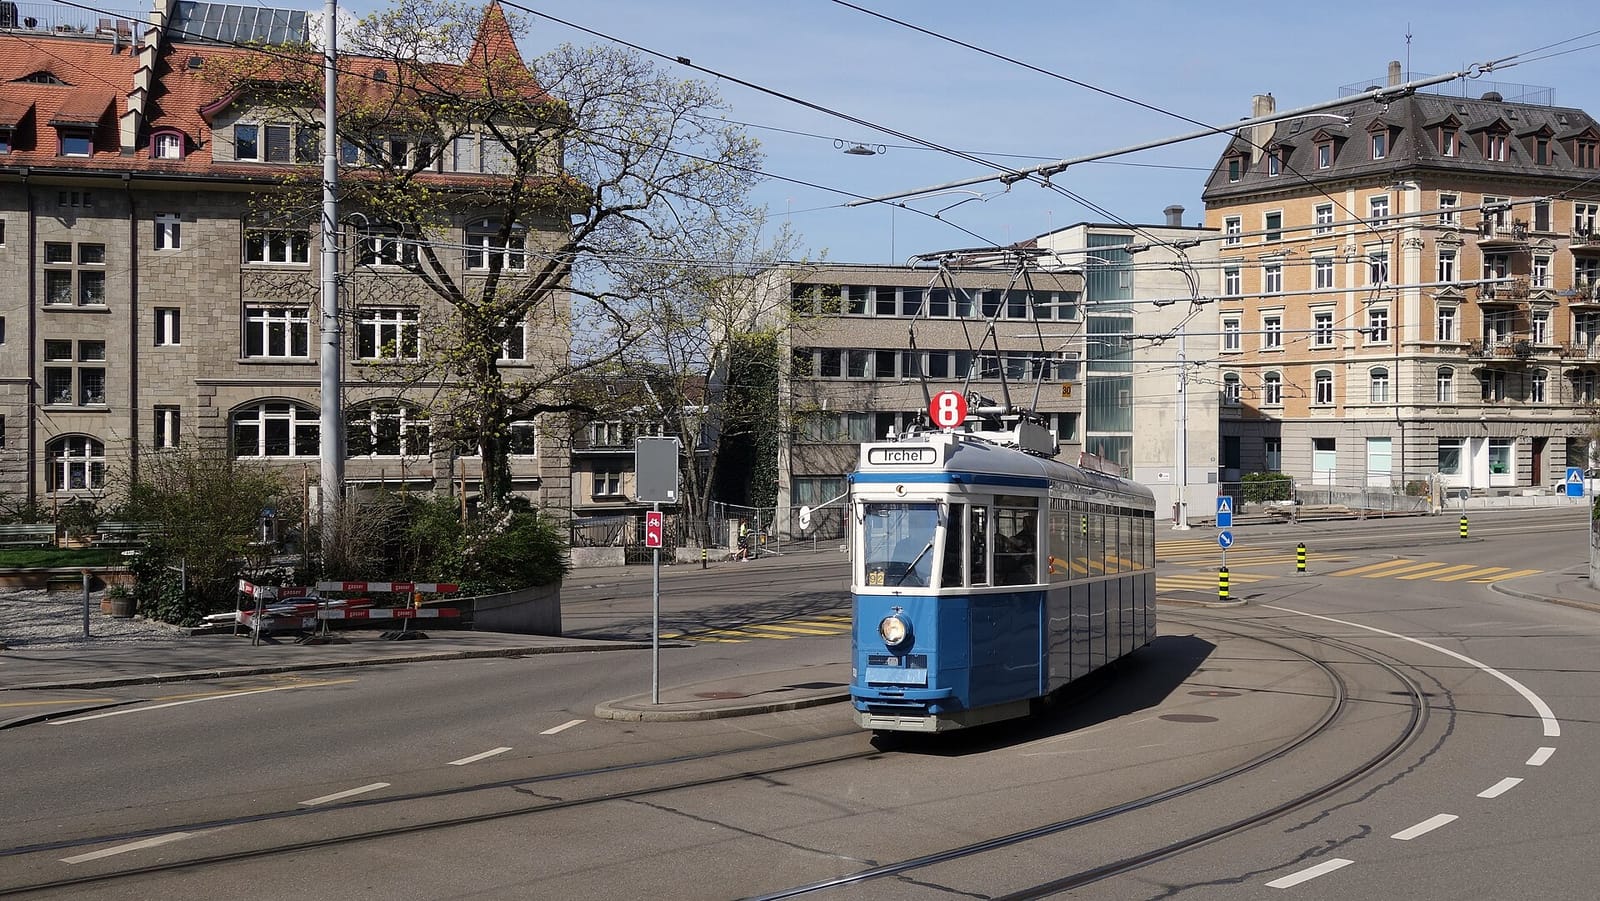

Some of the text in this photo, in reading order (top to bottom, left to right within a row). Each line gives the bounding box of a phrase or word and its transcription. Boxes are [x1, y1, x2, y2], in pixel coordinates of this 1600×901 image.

[1063, 386, 1071, 394] 30
[939, 393, 958, 426] 8
[884, 449, 922, 461] Irchel
